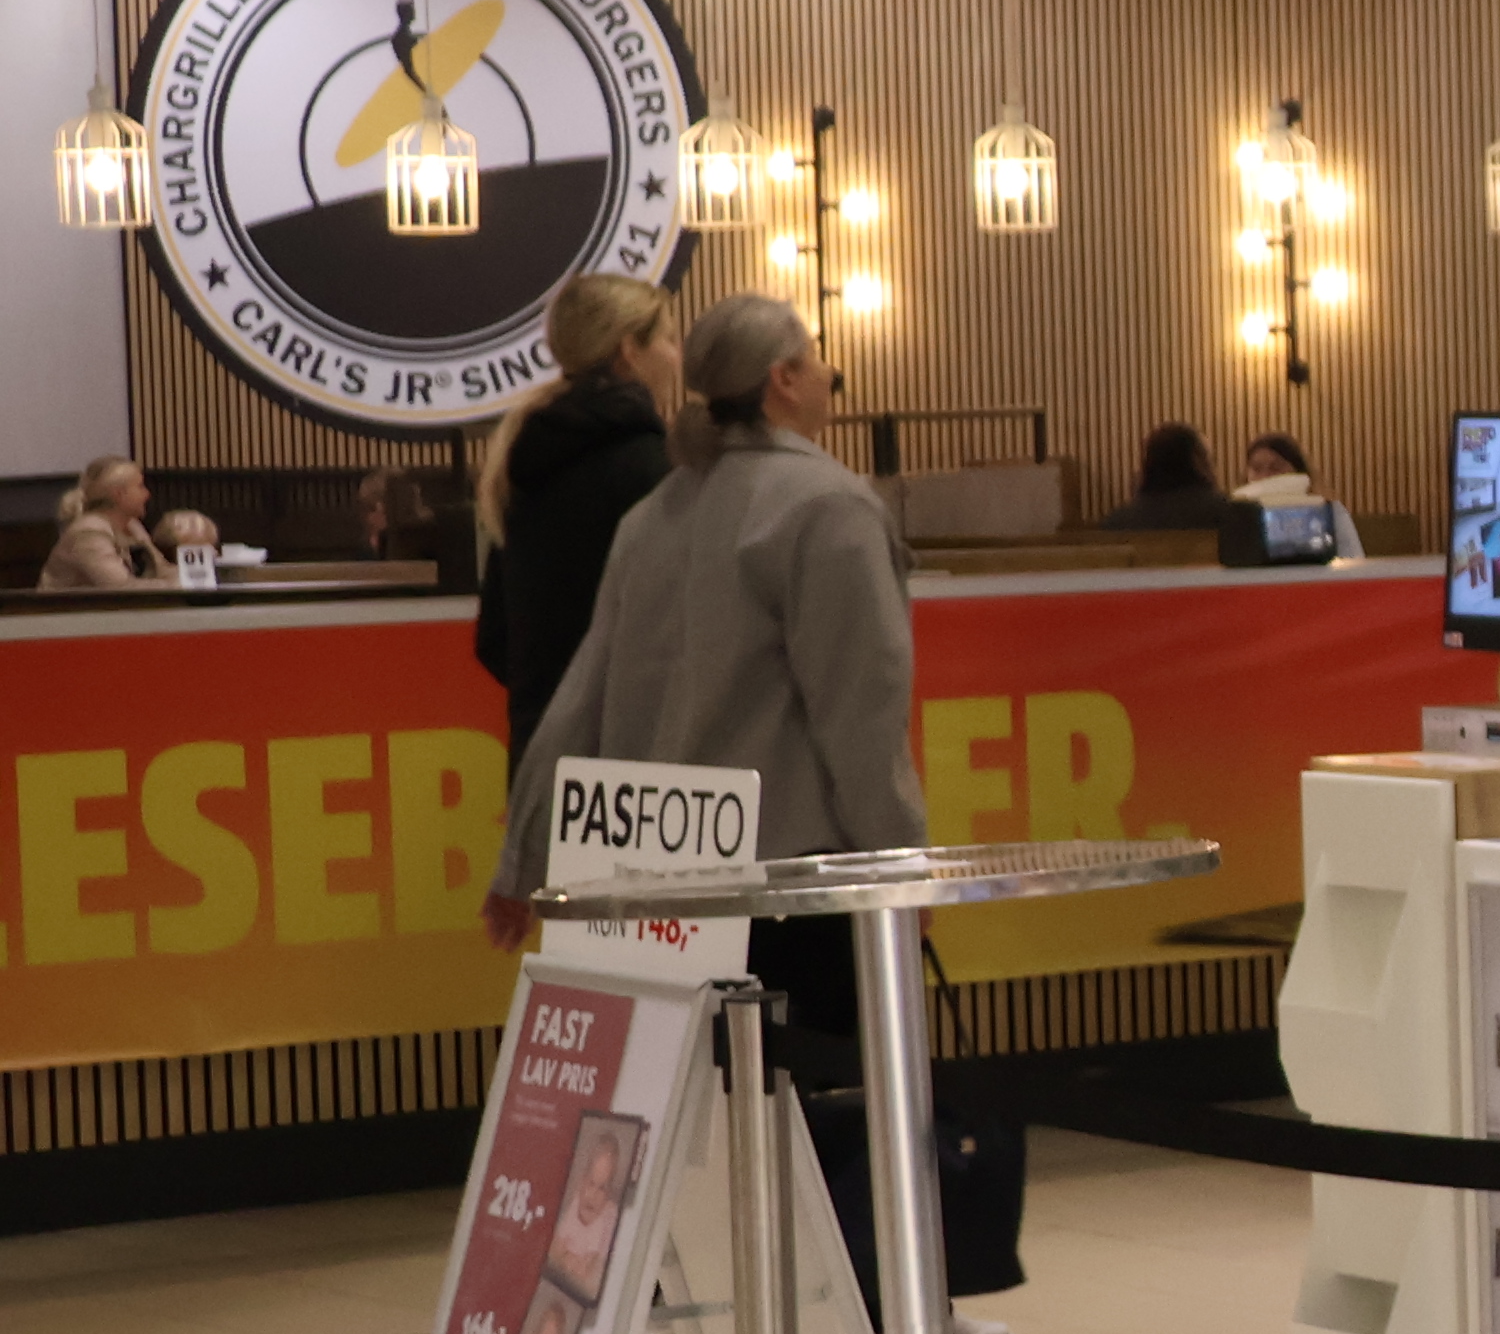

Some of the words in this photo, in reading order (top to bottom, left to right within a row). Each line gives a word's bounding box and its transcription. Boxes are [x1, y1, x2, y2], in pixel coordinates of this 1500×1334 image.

[231, 299, 368, 396] CARL'S
[459, 337, 556, 399] SINC
[558, 778, 745, 858] PASFOTO
[529, 1002, 596, 1053] FAST
[521, 1054, 557, 1088] LAV
[556, 1060, 600, 1097] PRIS
